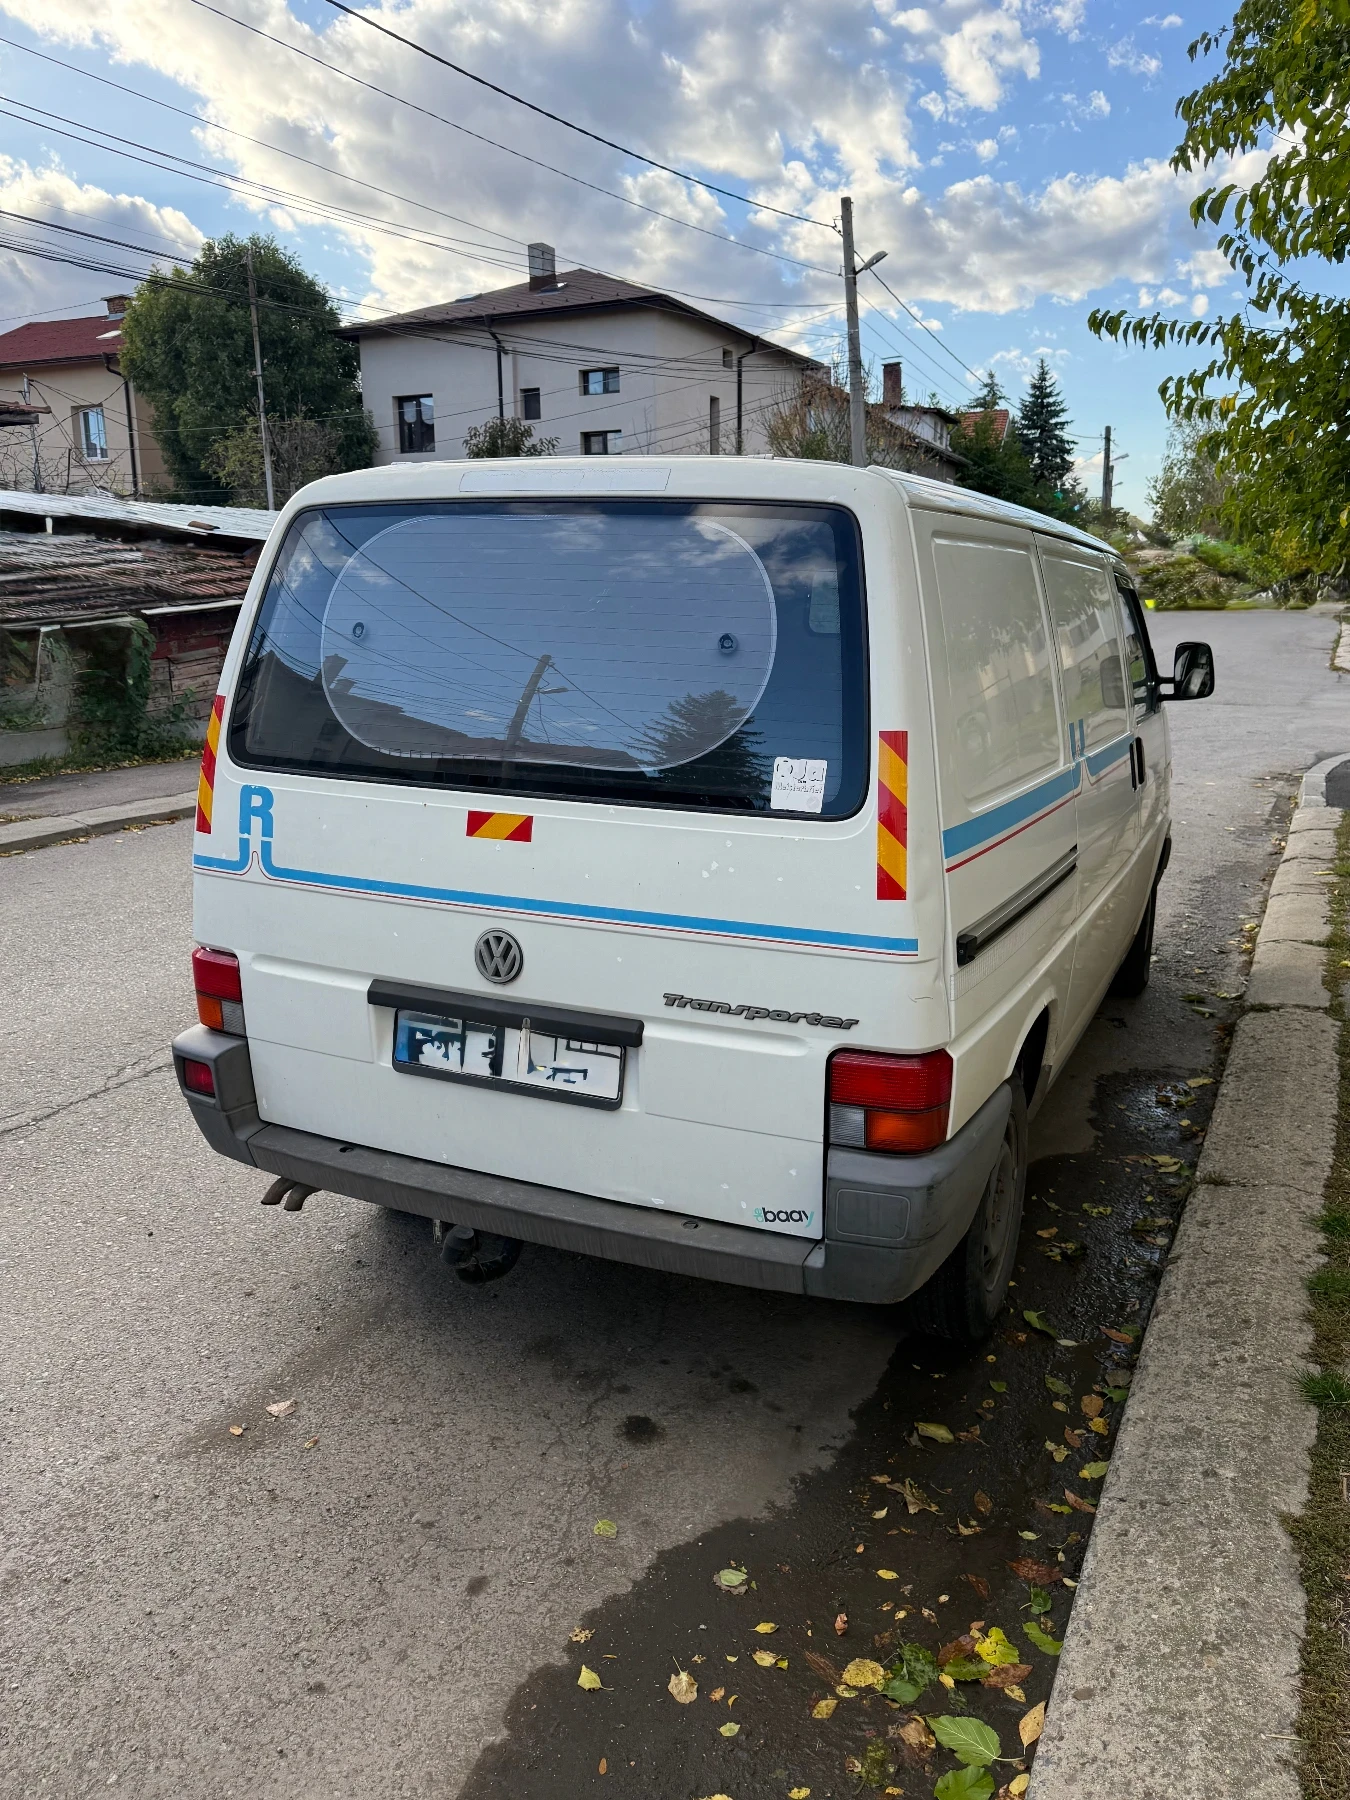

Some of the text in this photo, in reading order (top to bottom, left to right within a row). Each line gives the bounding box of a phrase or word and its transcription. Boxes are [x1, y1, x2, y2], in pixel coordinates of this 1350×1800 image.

[239, 784, 274, 838] R
[477, 930, 521, 983] VW
[663, 993, 859, 1030] Transporter
